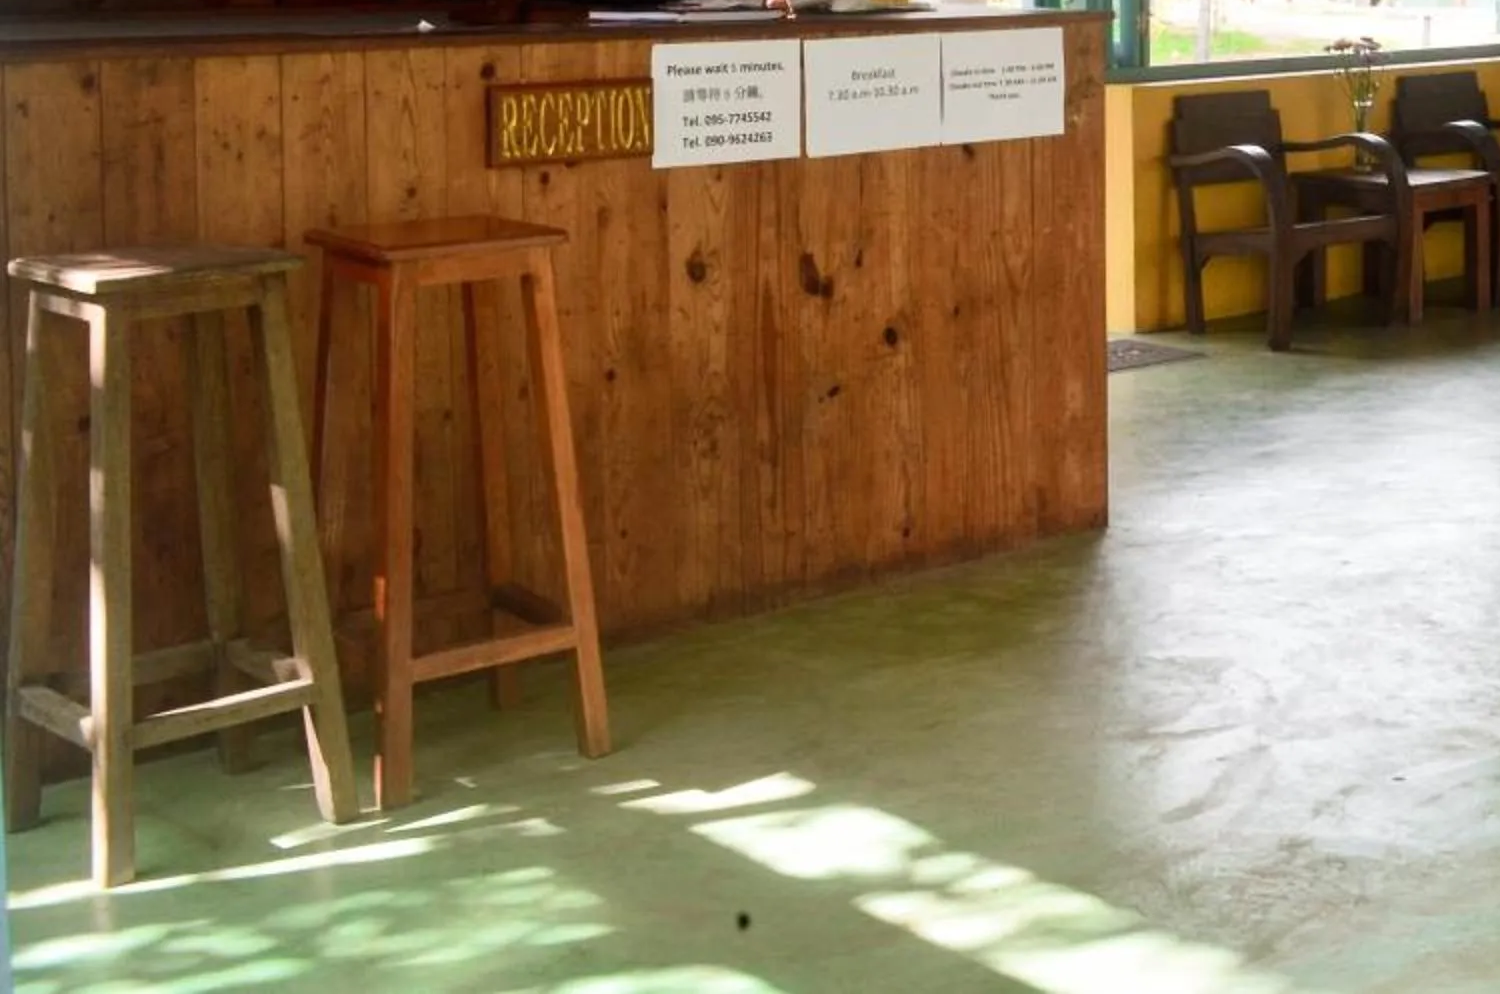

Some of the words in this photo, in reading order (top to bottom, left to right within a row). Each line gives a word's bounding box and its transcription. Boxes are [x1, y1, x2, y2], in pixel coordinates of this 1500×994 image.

[667, 63, 702, 77] Please
[705, 62, 729, 74] wait
[501, 87, 651, 158] RECEPTION
[682, 116, 702, 127] Tel.
[682, 137, 702, 149] Tel.
